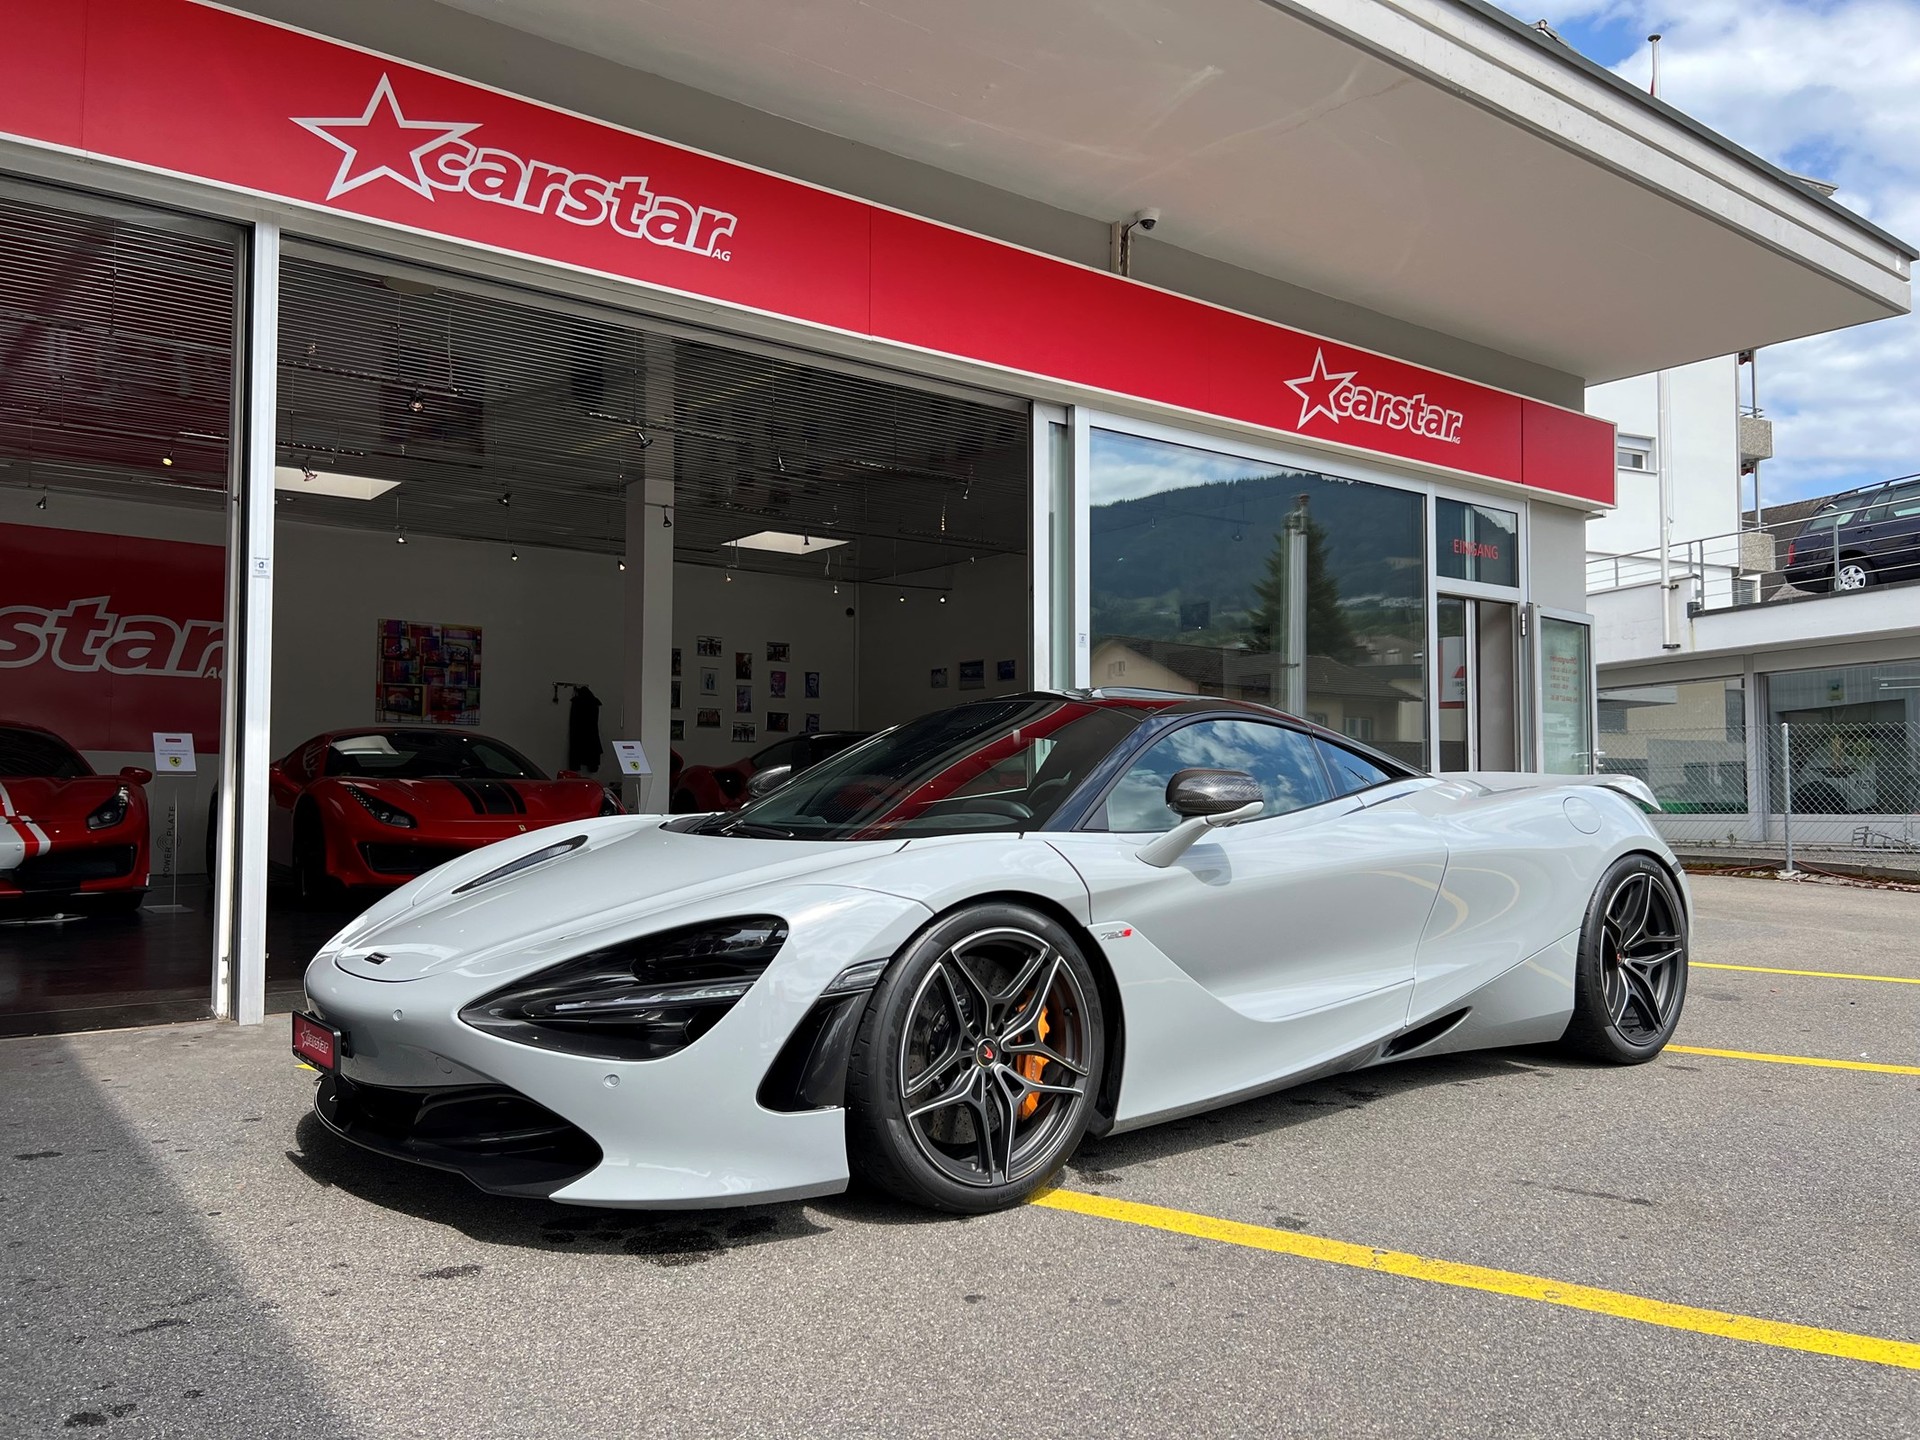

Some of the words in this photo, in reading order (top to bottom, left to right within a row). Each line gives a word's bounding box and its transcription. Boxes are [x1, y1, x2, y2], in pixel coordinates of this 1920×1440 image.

[419, 136, 738, 258] carstar
[711, 249, 732, 263] AG
[1335, 383, 1463, 442] carstar
[1452, 436, 1461, 445] AG
[1453, 539, 1499, 560] EINGANG
[166, 806, 176, 837] PLATE
